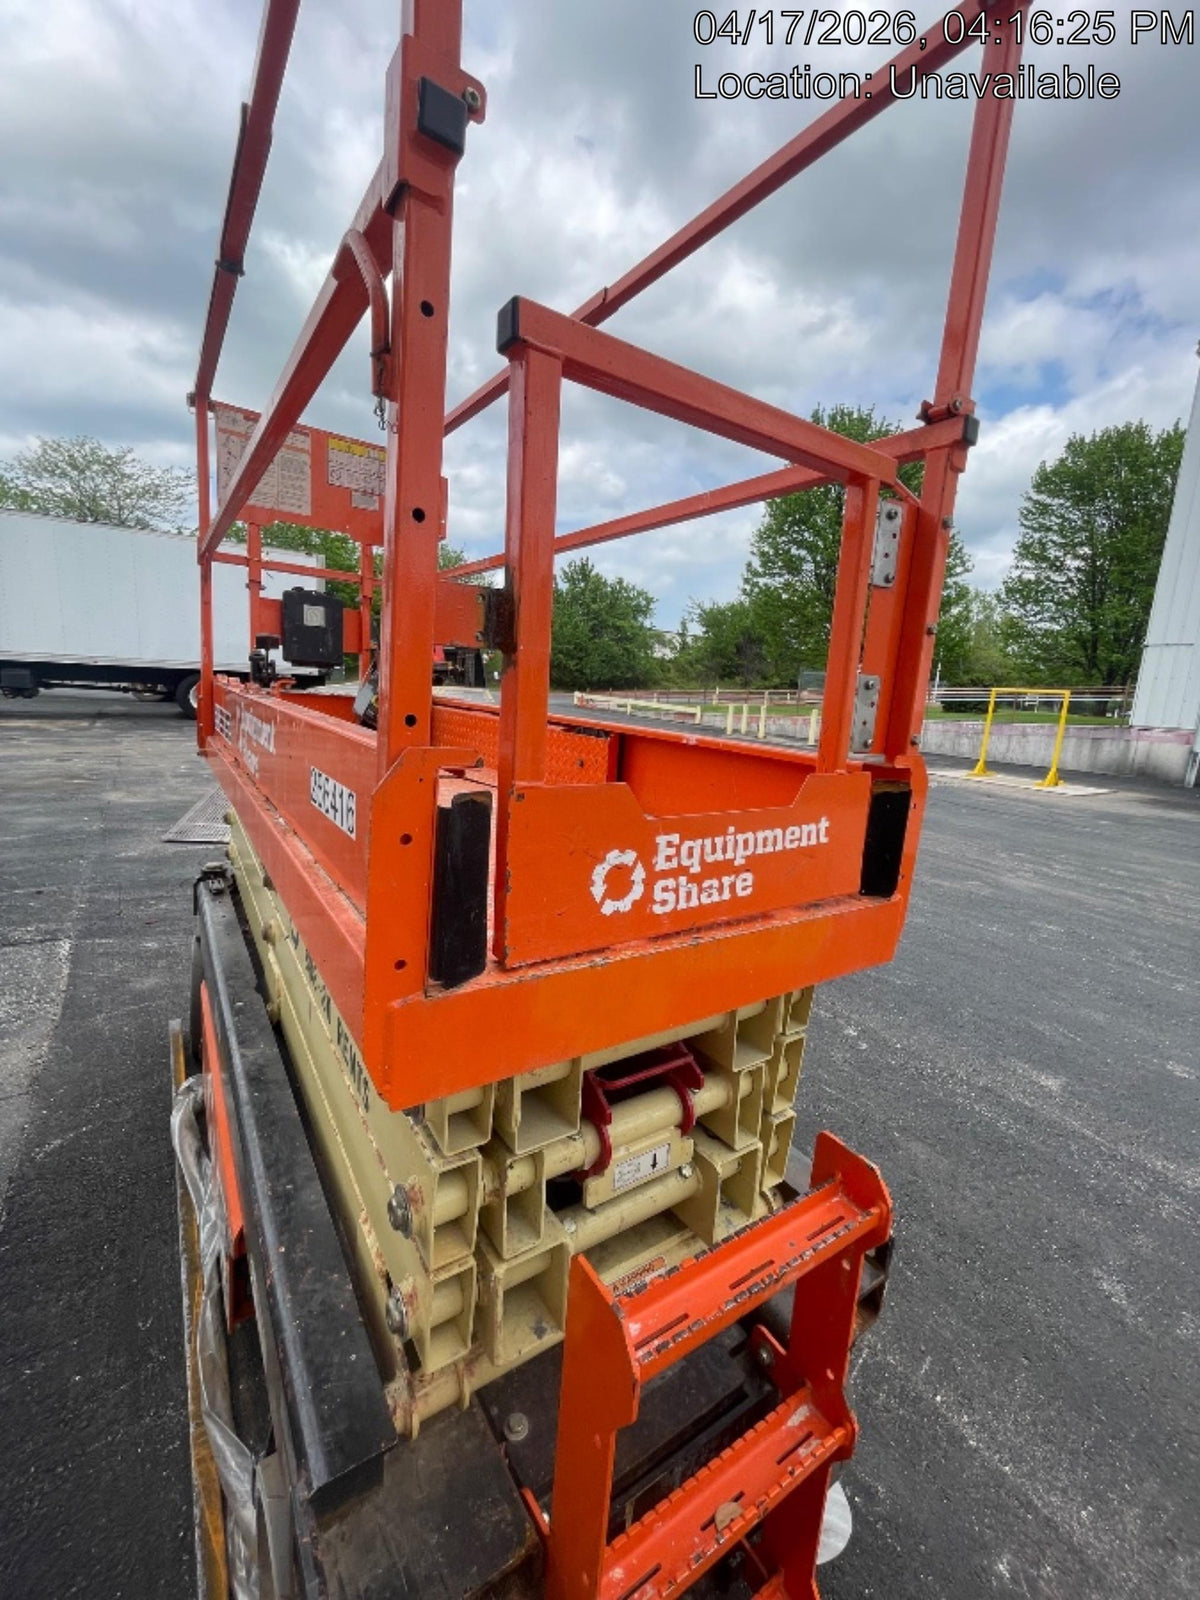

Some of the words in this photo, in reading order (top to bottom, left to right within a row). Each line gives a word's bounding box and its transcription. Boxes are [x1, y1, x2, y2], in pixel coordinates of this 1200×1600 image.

[652, 816, 831, 874] Equipment
[651, 870, 755, 915] Share
[336, 1016, 370, 1114] RENTS
